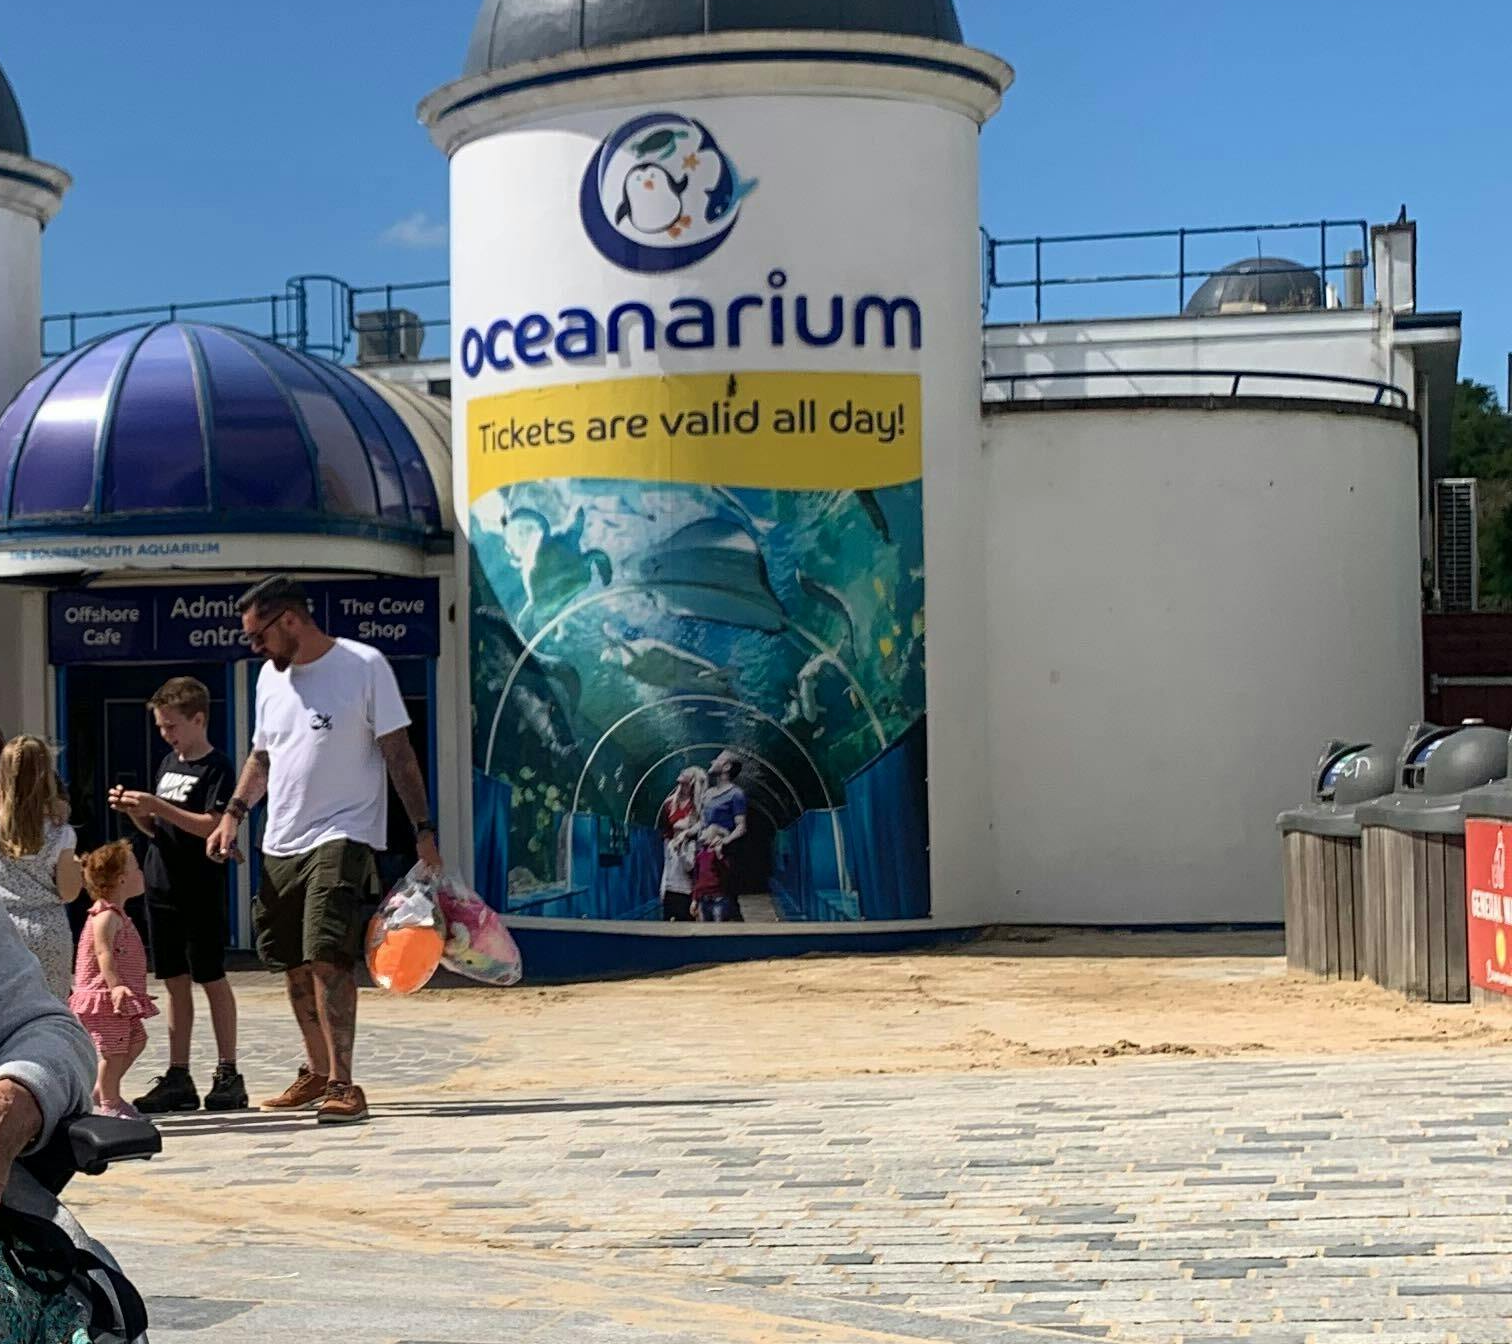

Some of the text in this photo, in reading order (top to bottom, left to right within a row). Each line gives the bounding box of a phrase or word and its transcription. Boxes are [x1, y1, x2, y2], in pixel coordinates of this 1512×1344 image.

[462, 270, 922, 378] oceanarium
[479, 399, 905, 455] Tickets are valid all day!
[138, 542, 220, 555] AQUARIUM
[64, 607, 140, 625] Offshore
[341, 598, 425, 615] The Cove
[83, 629, 122, 646] Cafe
[189, 625, 252, 647] entra
[358, 621, 407, 641] Shop
